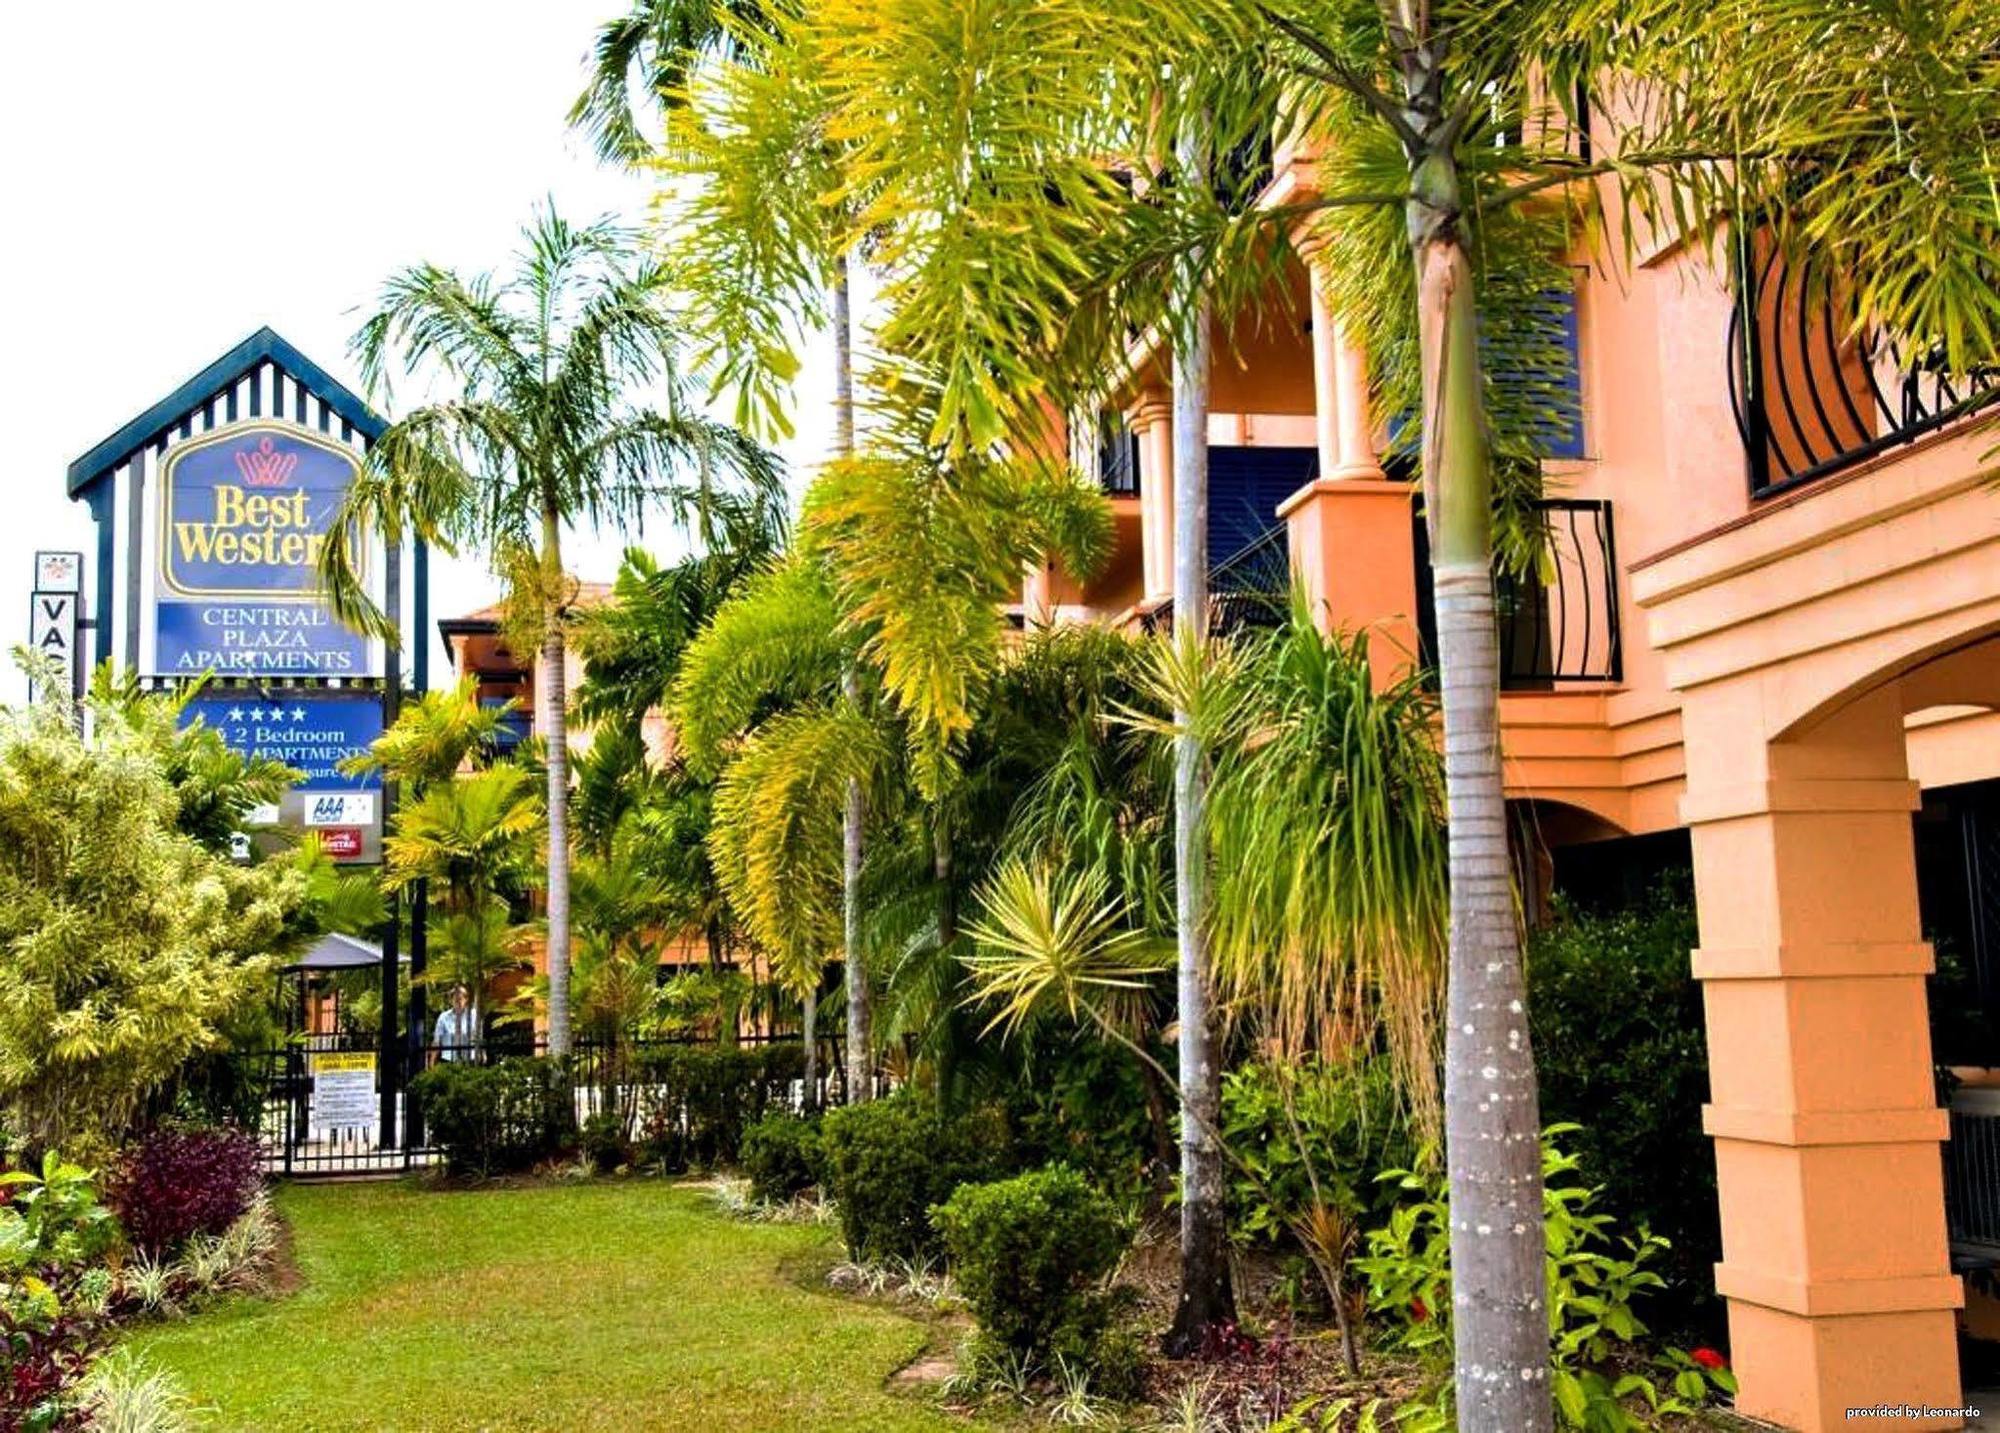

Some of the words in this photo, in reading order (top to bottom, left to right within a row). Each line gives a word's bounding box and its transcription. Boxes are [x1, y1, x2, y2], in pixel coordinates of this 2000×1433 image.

[214, 485, 310, 528] Best
[203, 608, 327, 626] CENTRAL
[223, 630, 308, 647] PLAZA
[177, 651, 351, 669] APARTMENTS
[235, 728, 247, 743] 2
[256, 728, 345, 743] Bedroom
[314, 797, 344, 815] AAA
